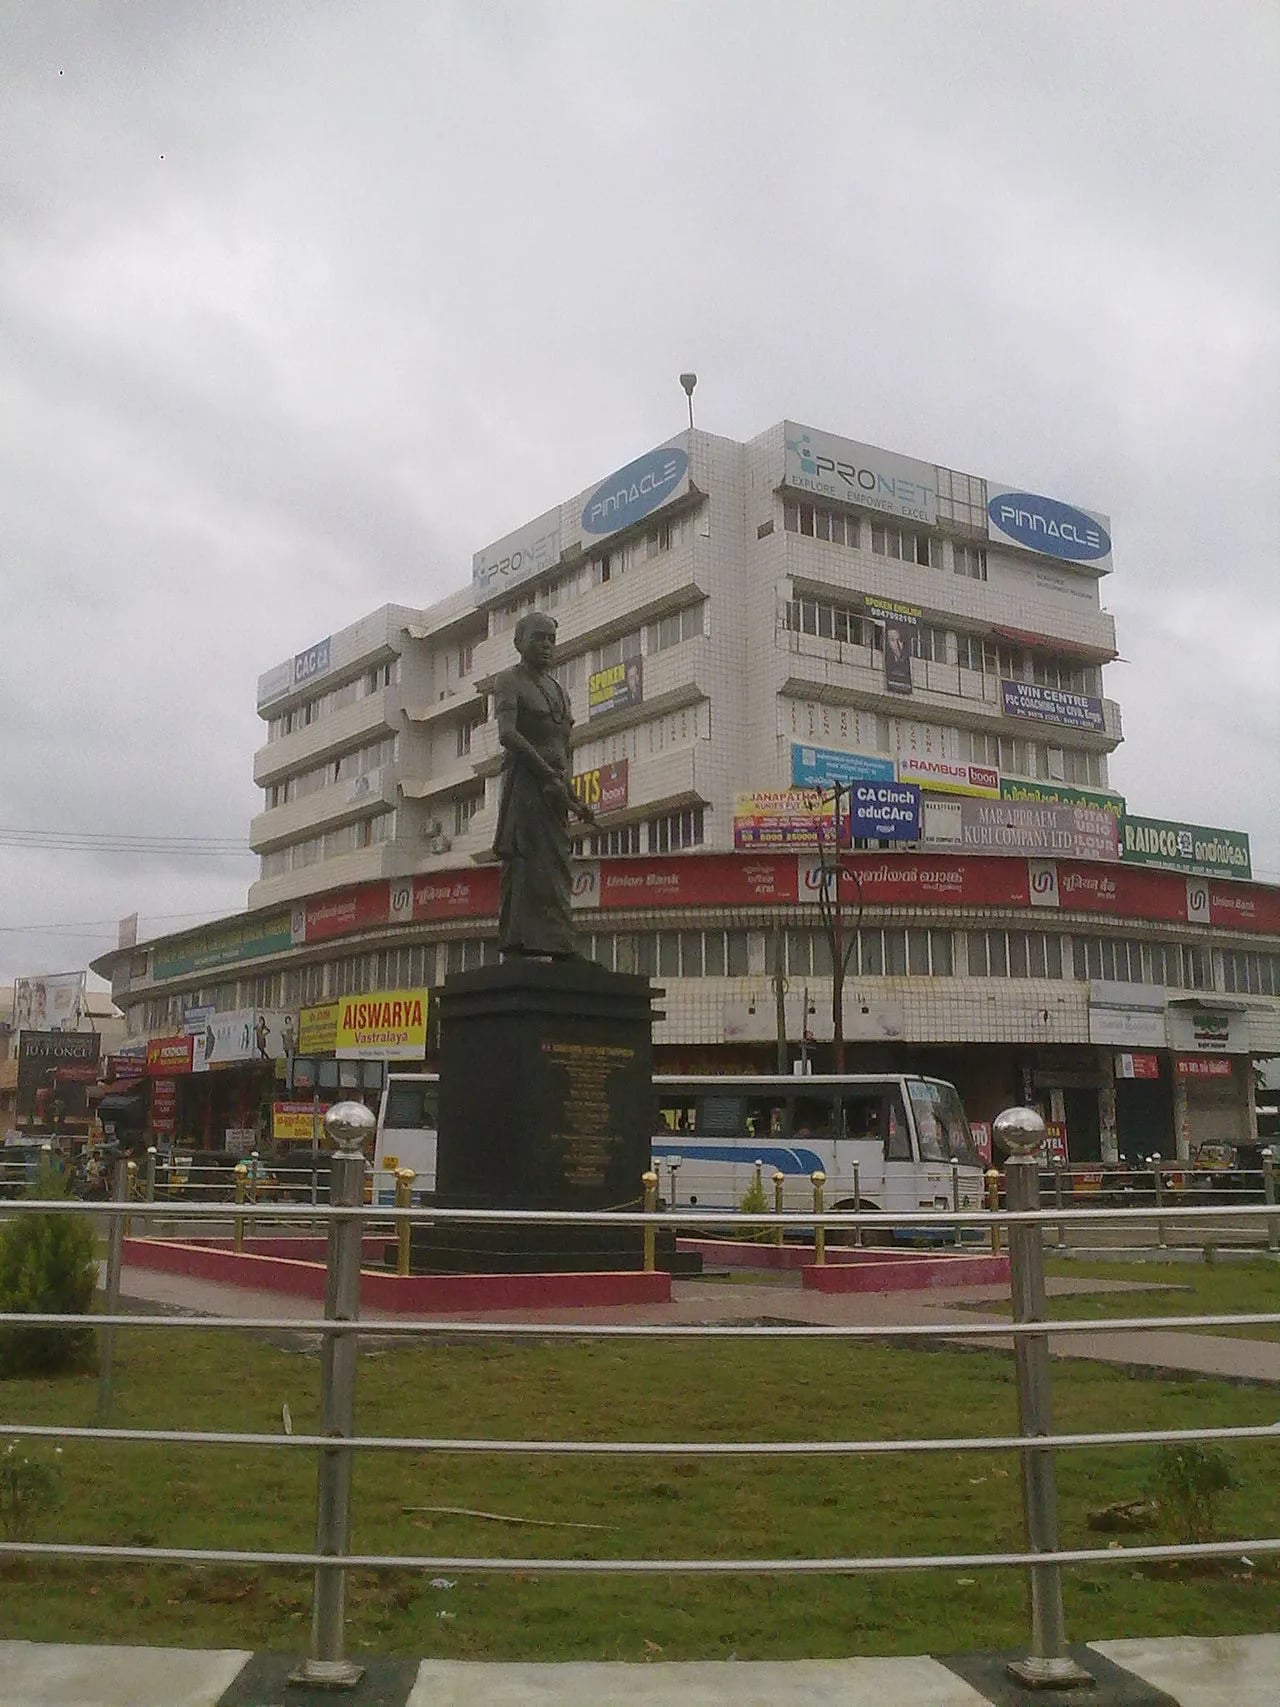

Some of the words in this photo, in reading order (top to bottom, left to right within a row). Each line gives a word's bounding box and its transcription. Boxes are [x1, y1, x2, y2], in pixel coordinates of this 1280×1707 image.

[592, 460, 676, 522] PINNACLE
[815, 455, 934, 506] PRONET
[792, 475, 836, 496] EXPLORE
[847, 491, 895, 511] EMPOWER
[902, 506, 930, 521] EXCEL
[1000, 505, 1100, 549] PINNACLE
[487, 528, 560, 585] PRONET
[590, 664, 625, 692] SPOKEN
[1017, 685, 1041, 699] WIN
[1043, 690, 1089, 708] CENTRE
[909, 759, 967, 778] RAMBUS
[970, 769, 997, 784] boon
[857, 788, 876, 801] CA
[878, 789, 915, 805] Cinch
[857, 806, 914, 821] eduCAre
[964, 826, 994, 844] KURI
[995, 827, 1048, 849] COMPANY
[1051, 832, 1073, 849] LTD
[1125, 825, 1177, 857] RAIDCO
[607, 876, 643, 887] Union
[646, 873, 680, 886] Bank
[342, 1000, 423, 1030] AISWARYA
[25, 1045, 50, 1057] JUST
[354, 1030, 409, 1046] Vastralaya
